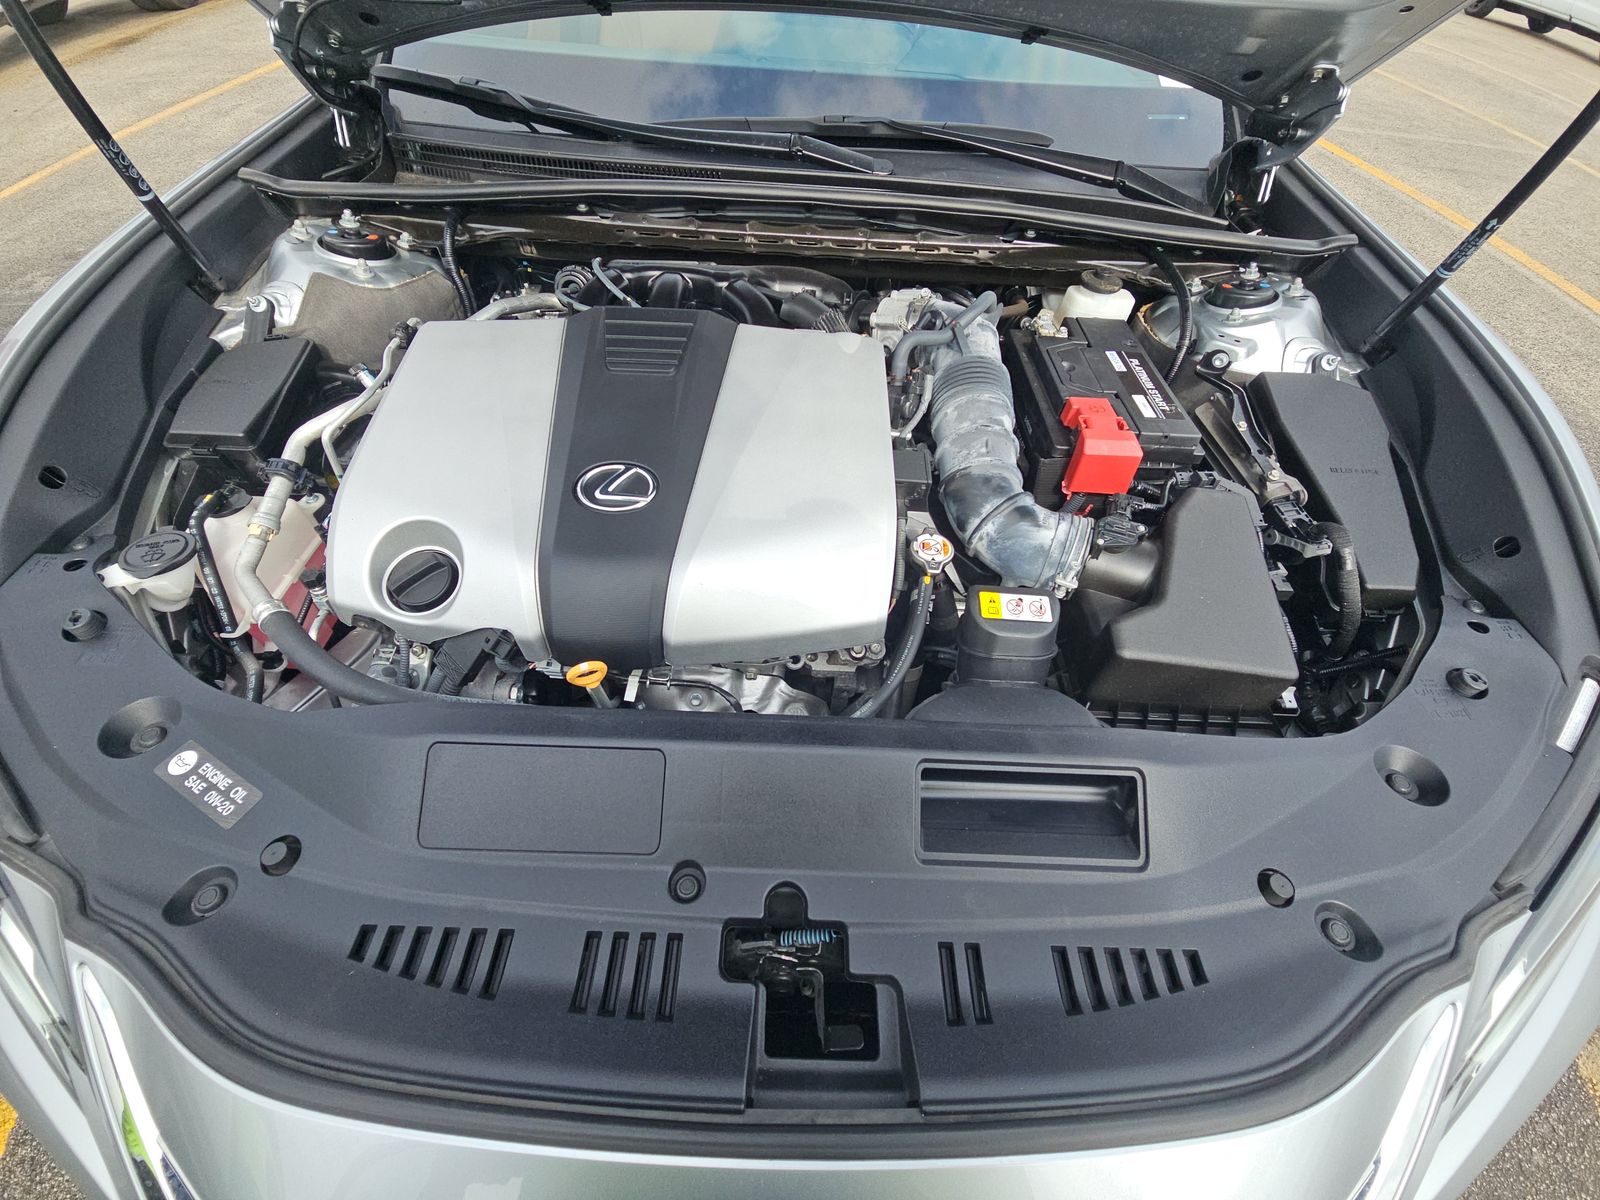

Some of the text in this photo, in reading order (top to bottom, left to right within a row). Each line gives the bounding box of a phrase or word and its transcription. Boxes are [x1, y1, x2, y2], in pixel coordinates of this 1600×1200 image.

[1128, 358, 1170, 411] PLATINUM START
[184, 775, 235, 816] SAE 0W-20
[198, 763, 248, 804] ENGINE OIL
